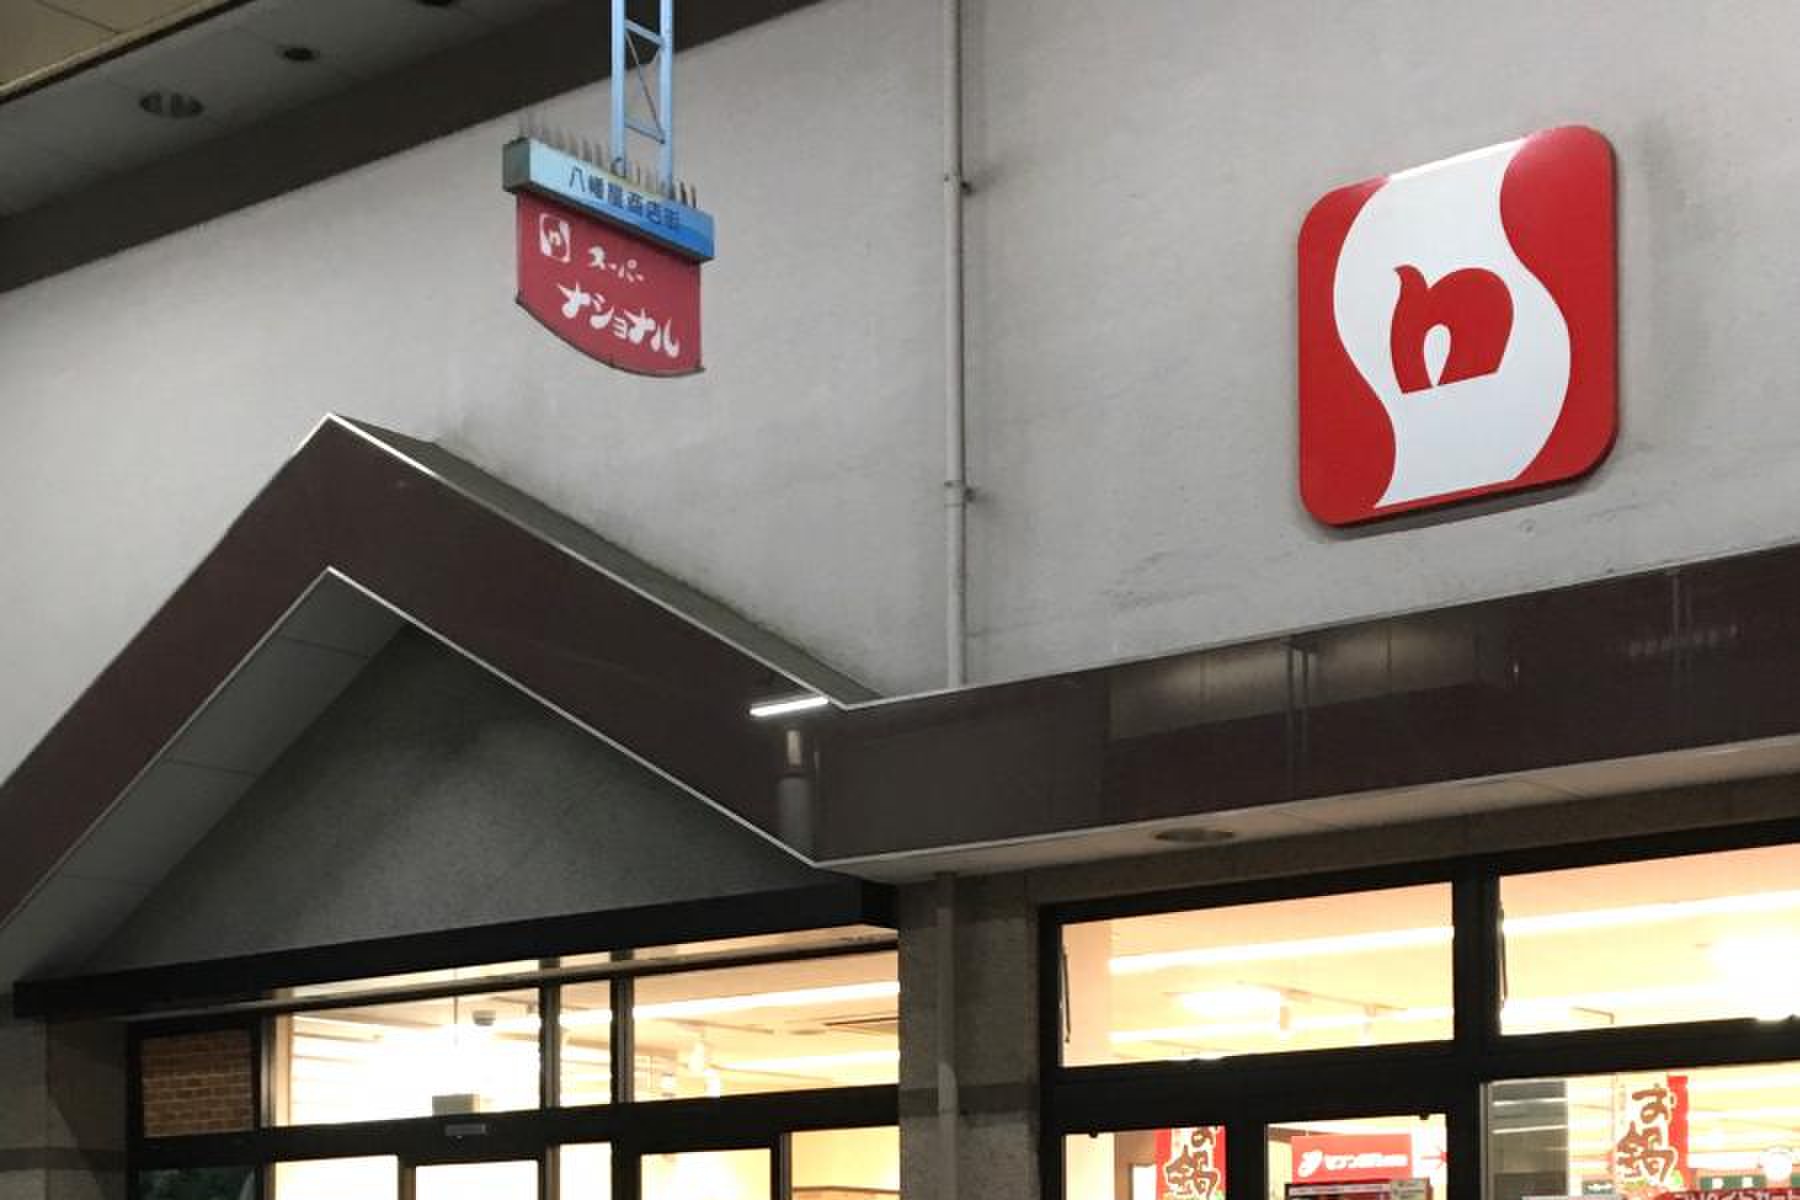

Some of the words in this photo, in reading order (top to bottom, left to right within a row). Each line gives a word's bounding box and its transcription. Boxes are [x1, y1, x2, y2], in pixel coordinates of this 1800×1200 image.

[588, 246, 644, 283] スーパー
[557, 281, 681, 358] ナショナル
